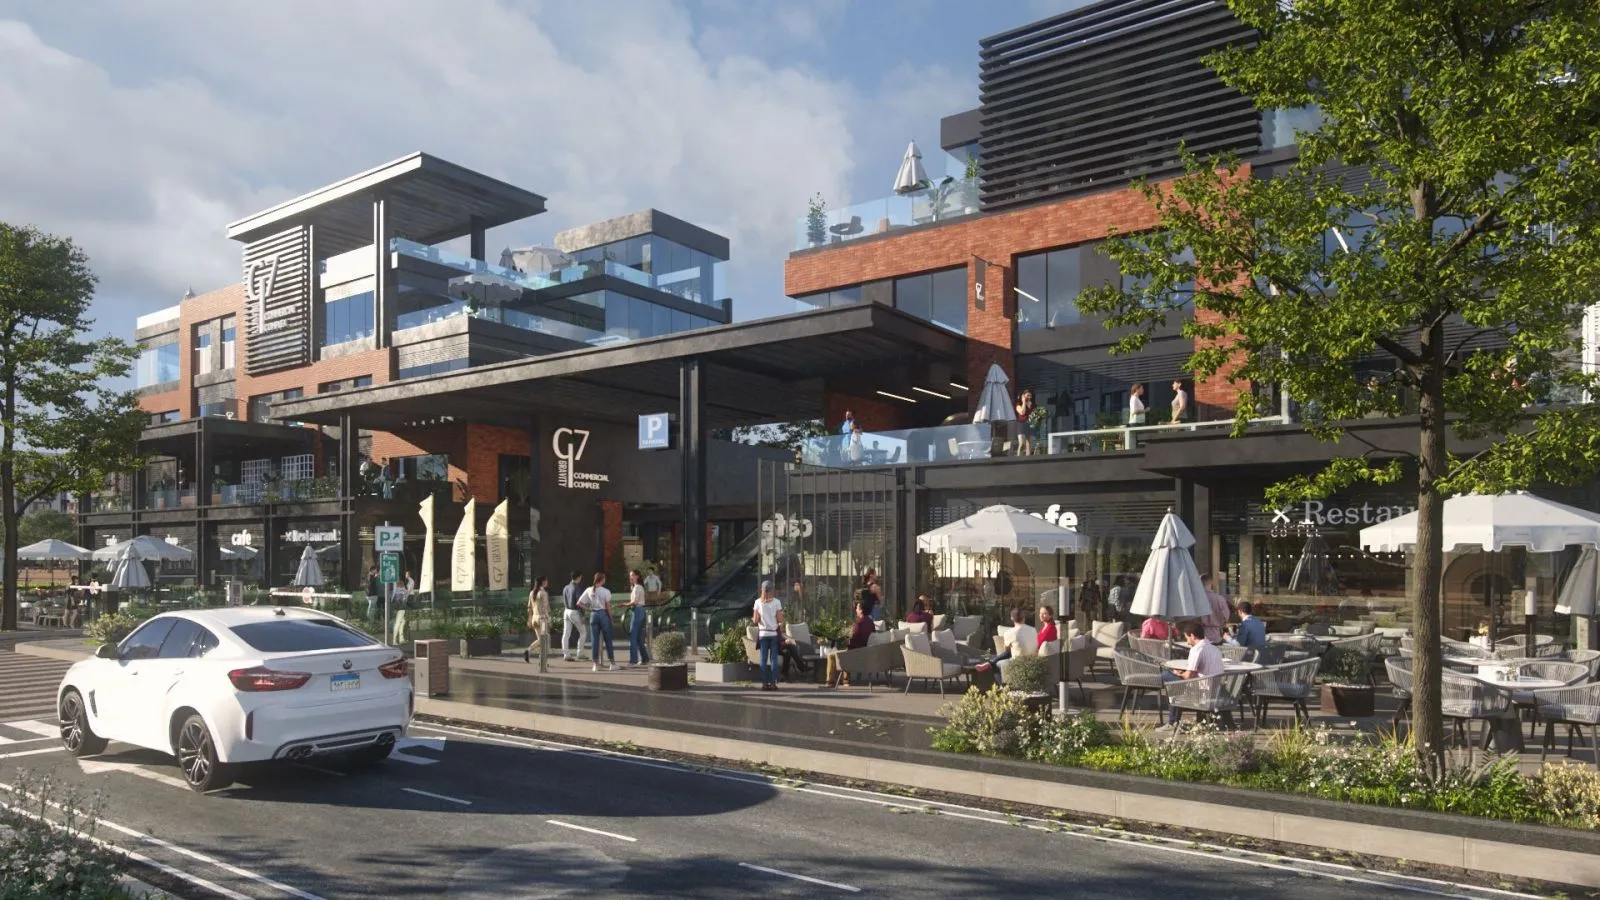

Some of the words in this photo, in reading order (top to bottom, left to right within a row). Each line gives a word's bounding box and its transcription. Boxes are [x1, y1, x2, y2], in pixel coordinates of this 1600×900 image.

[648, 415, 662, 439] P
[558, 460, 567, 487] GRAVITY
[574, 472, 609, 482] COMMERCIAL
[574, 481, 600, 489] COMPLEX
[231, 529, 252, 546] cafe
[380, 531, 391, 546] P
